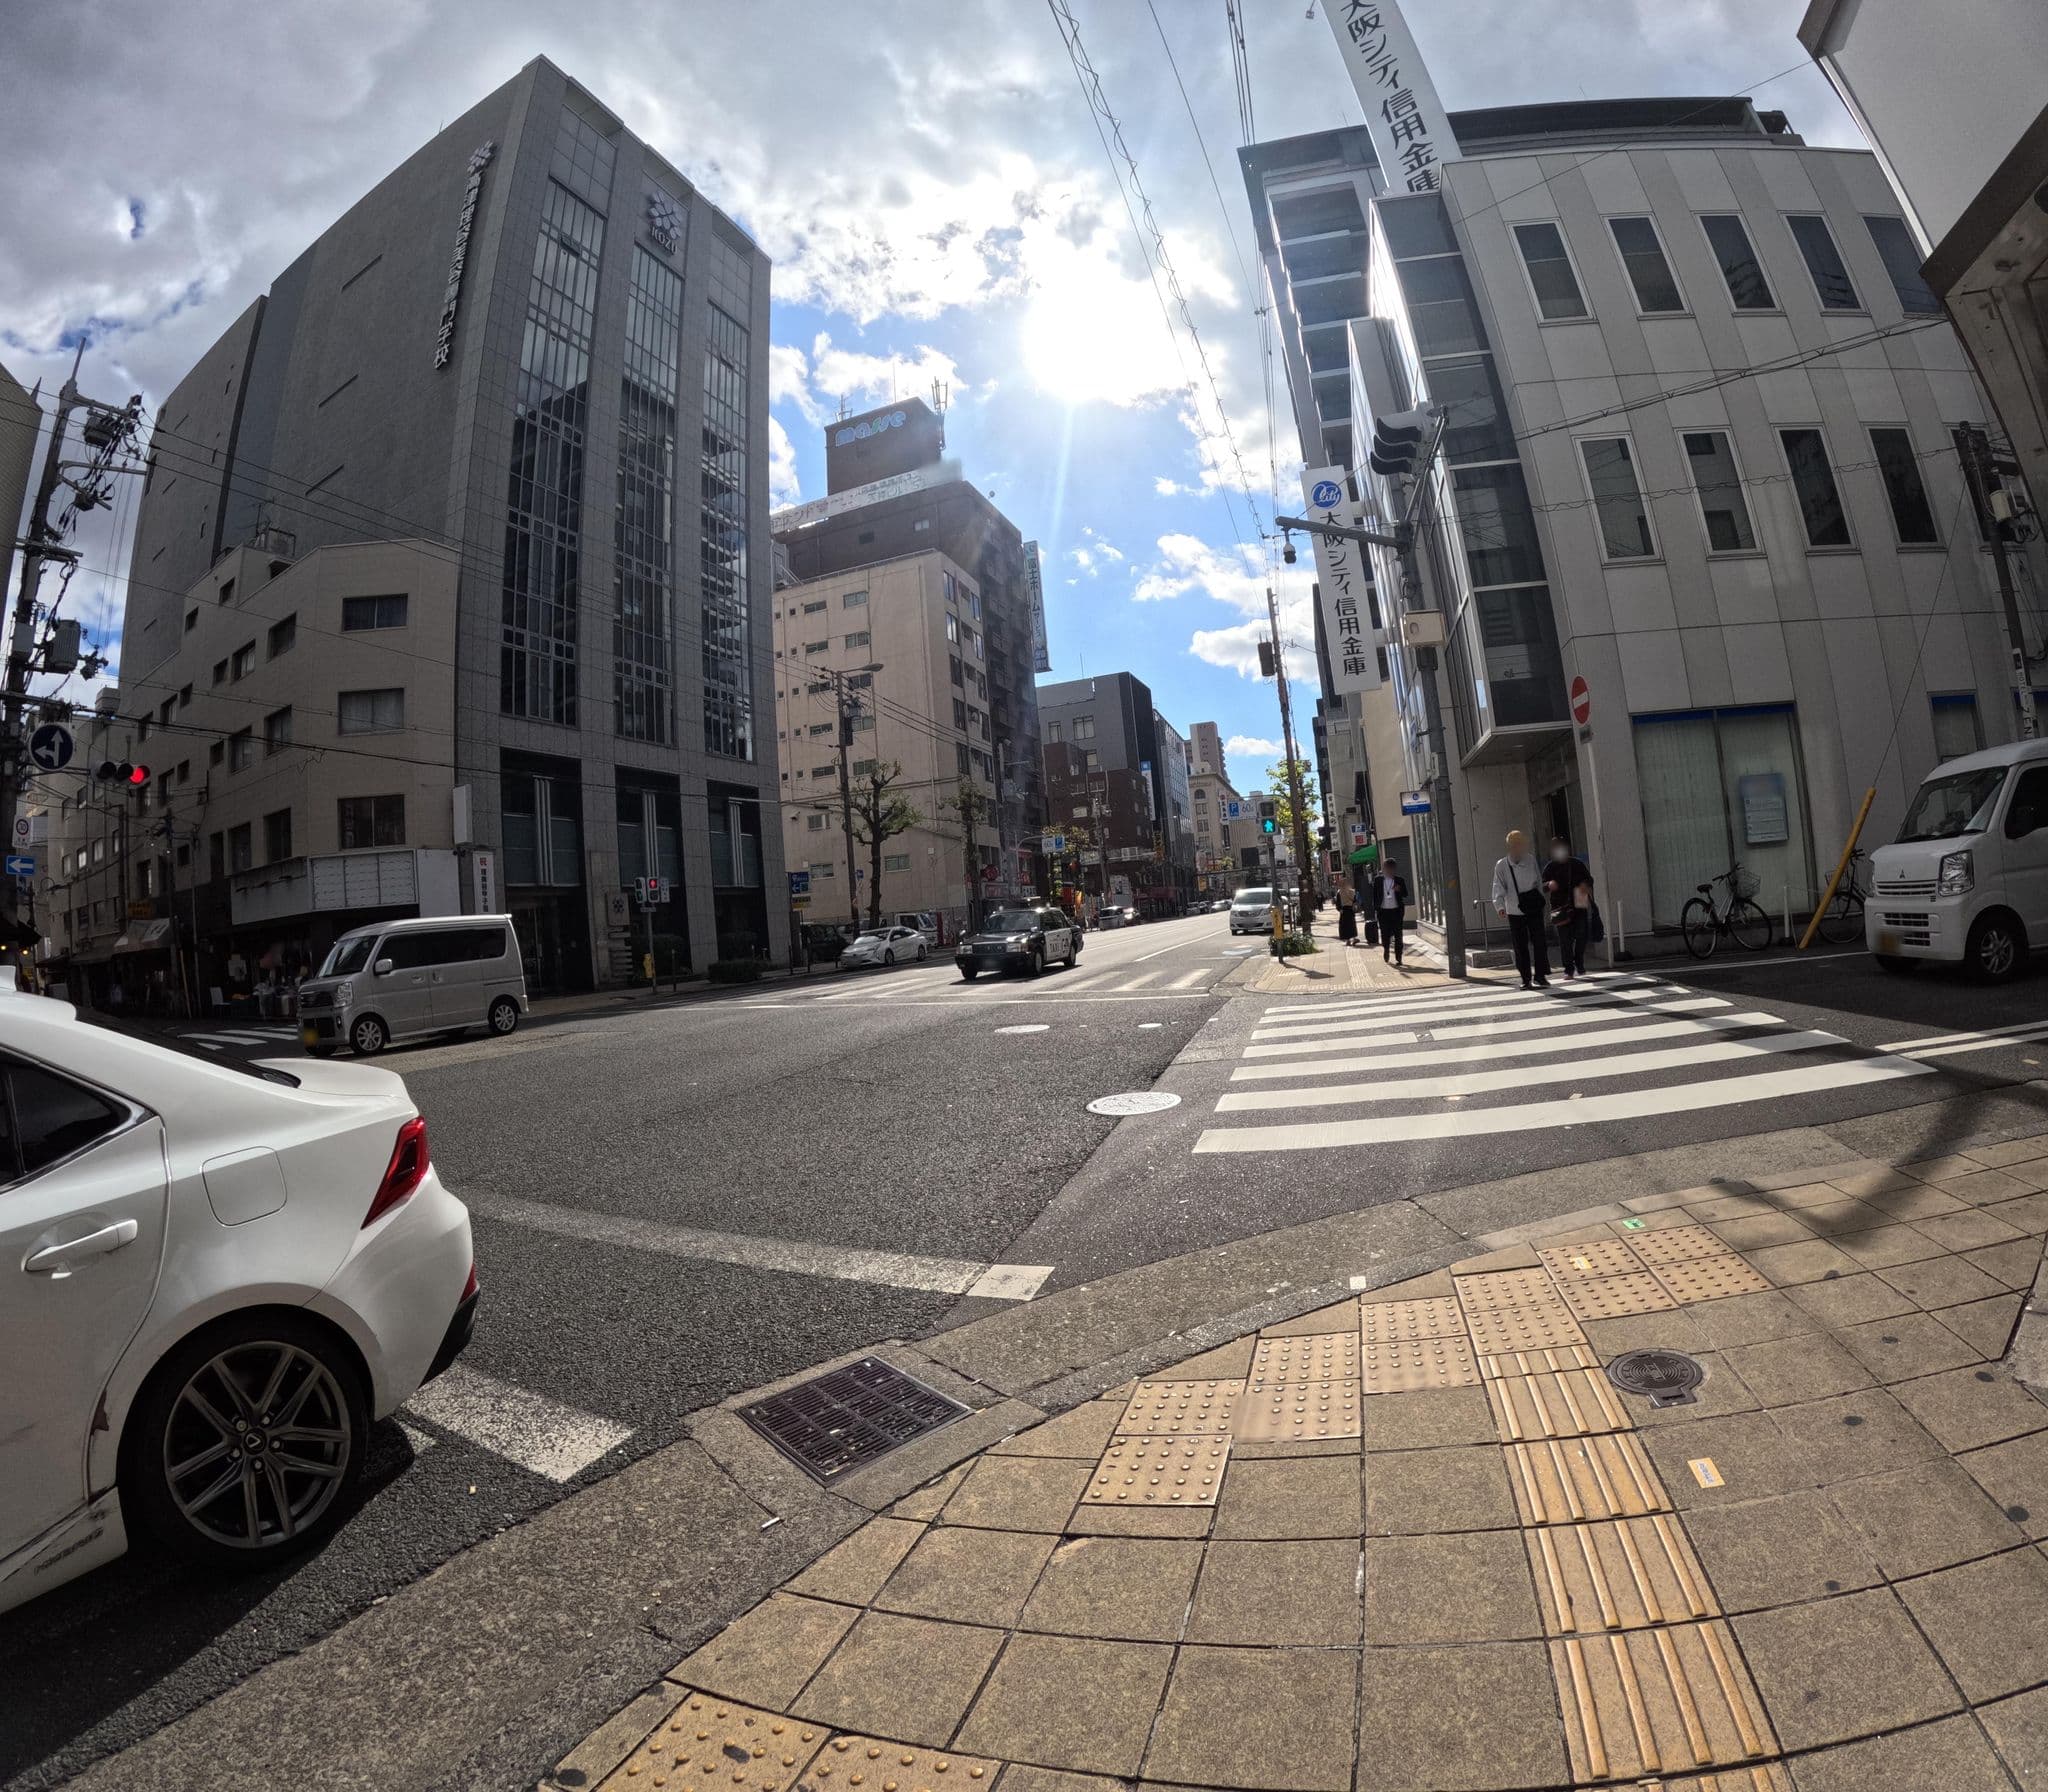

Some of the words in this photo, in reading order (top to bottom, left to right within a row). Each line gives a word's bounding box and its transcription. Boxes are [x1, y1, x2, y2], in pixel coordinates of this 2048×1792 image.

[1341, 0, 1440, 193] 大阪シティ信用金庫
[1320, 512, 1367, 677] 大阪シティ信用金庫
